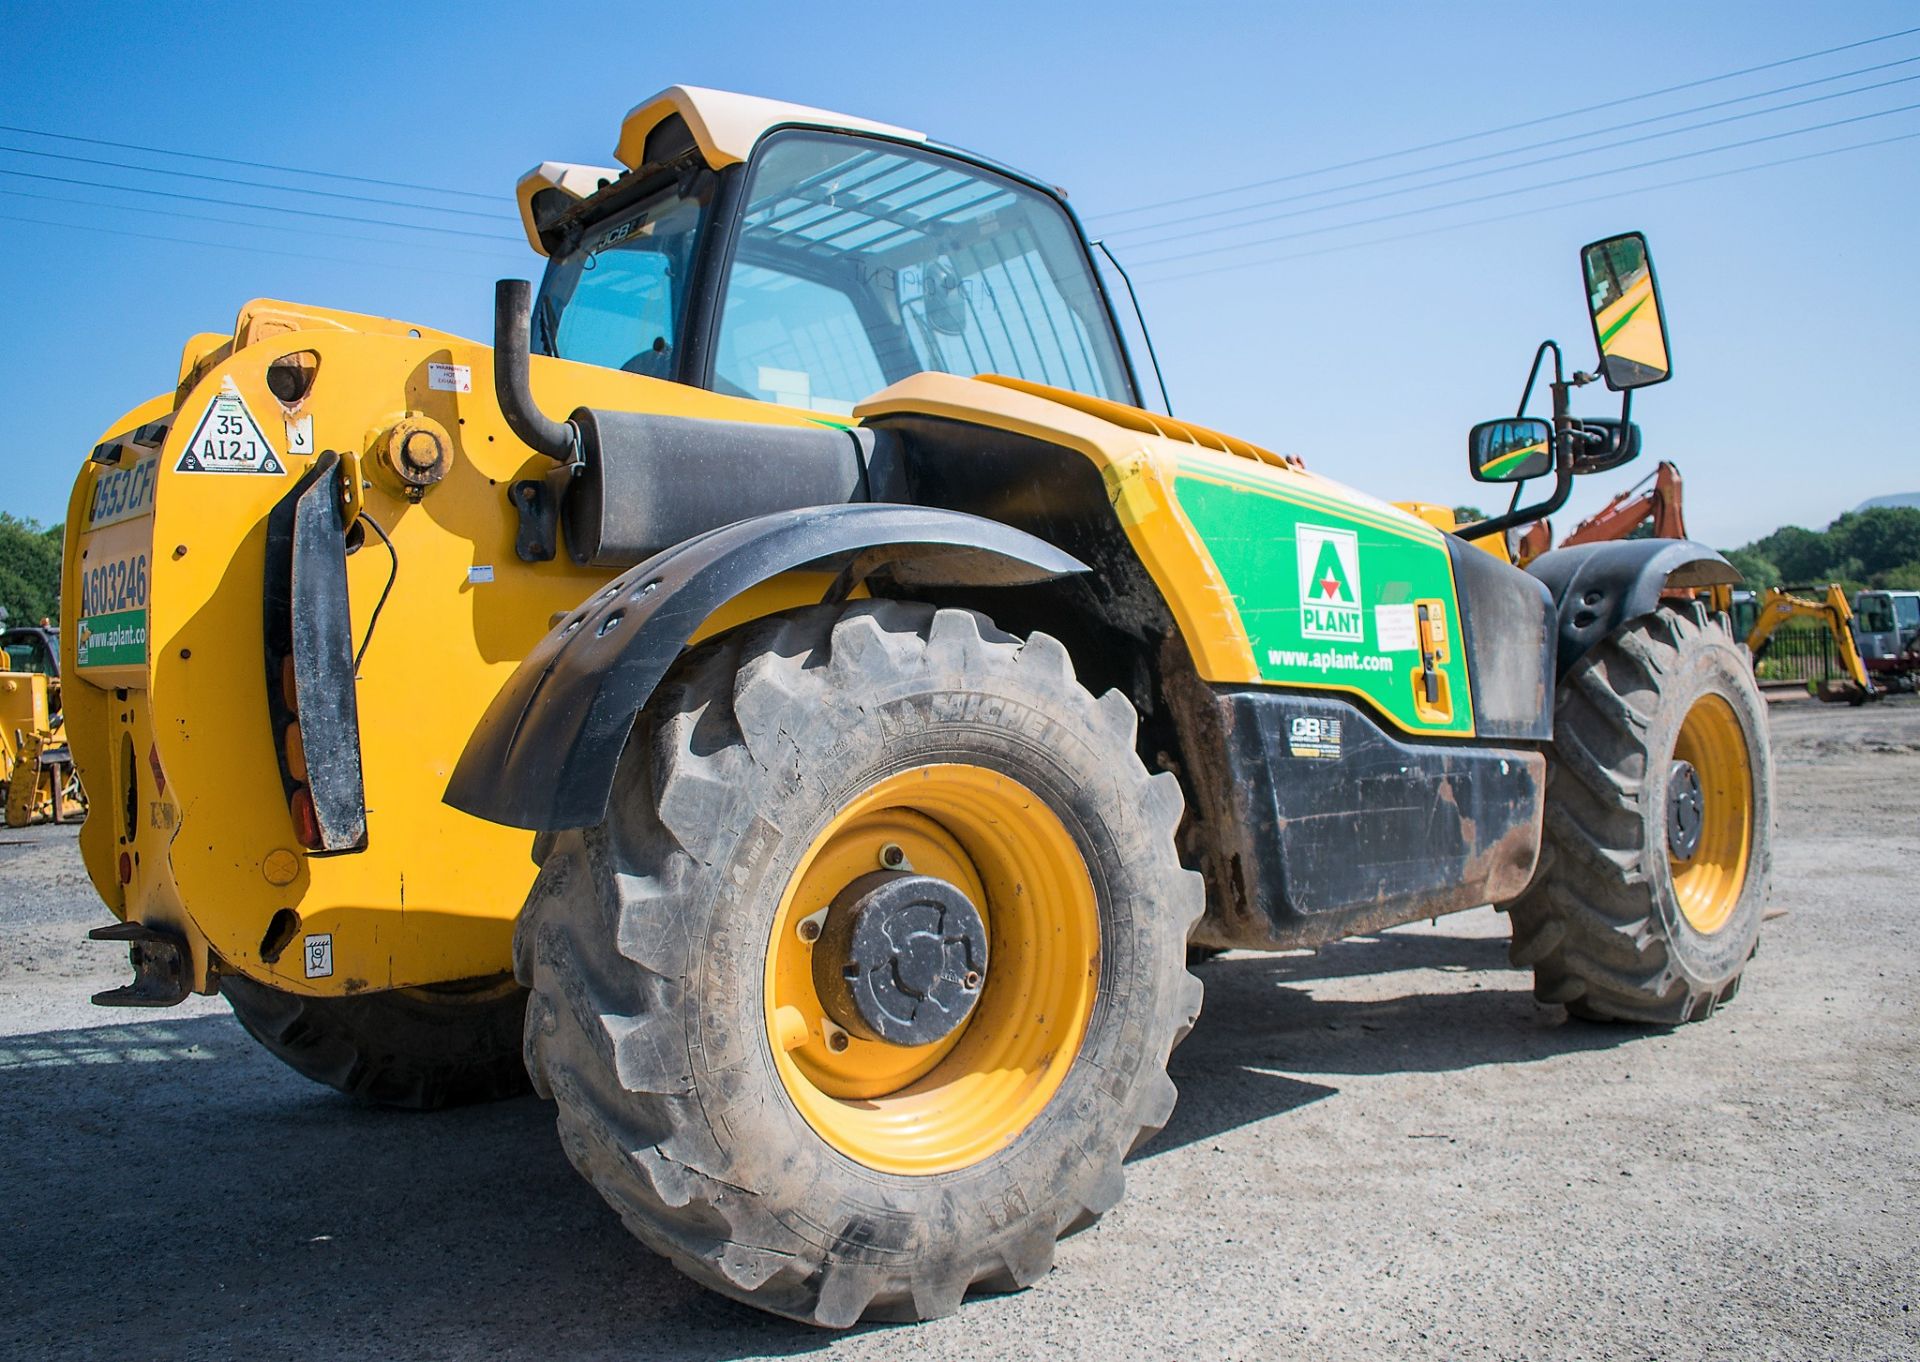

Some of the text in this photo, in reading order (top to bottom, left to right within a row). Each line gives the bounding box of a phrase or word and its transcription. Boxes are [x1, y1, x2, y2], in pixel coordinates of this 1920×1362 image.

[217, 415, 243, 436] 35
[1308, 540, 1355, 603] A
[82, 554, 146, 616] A603246
[1304, 609, 1360, 633] PLANT
[1268, 648, 1393, 673] www.aplant.com
